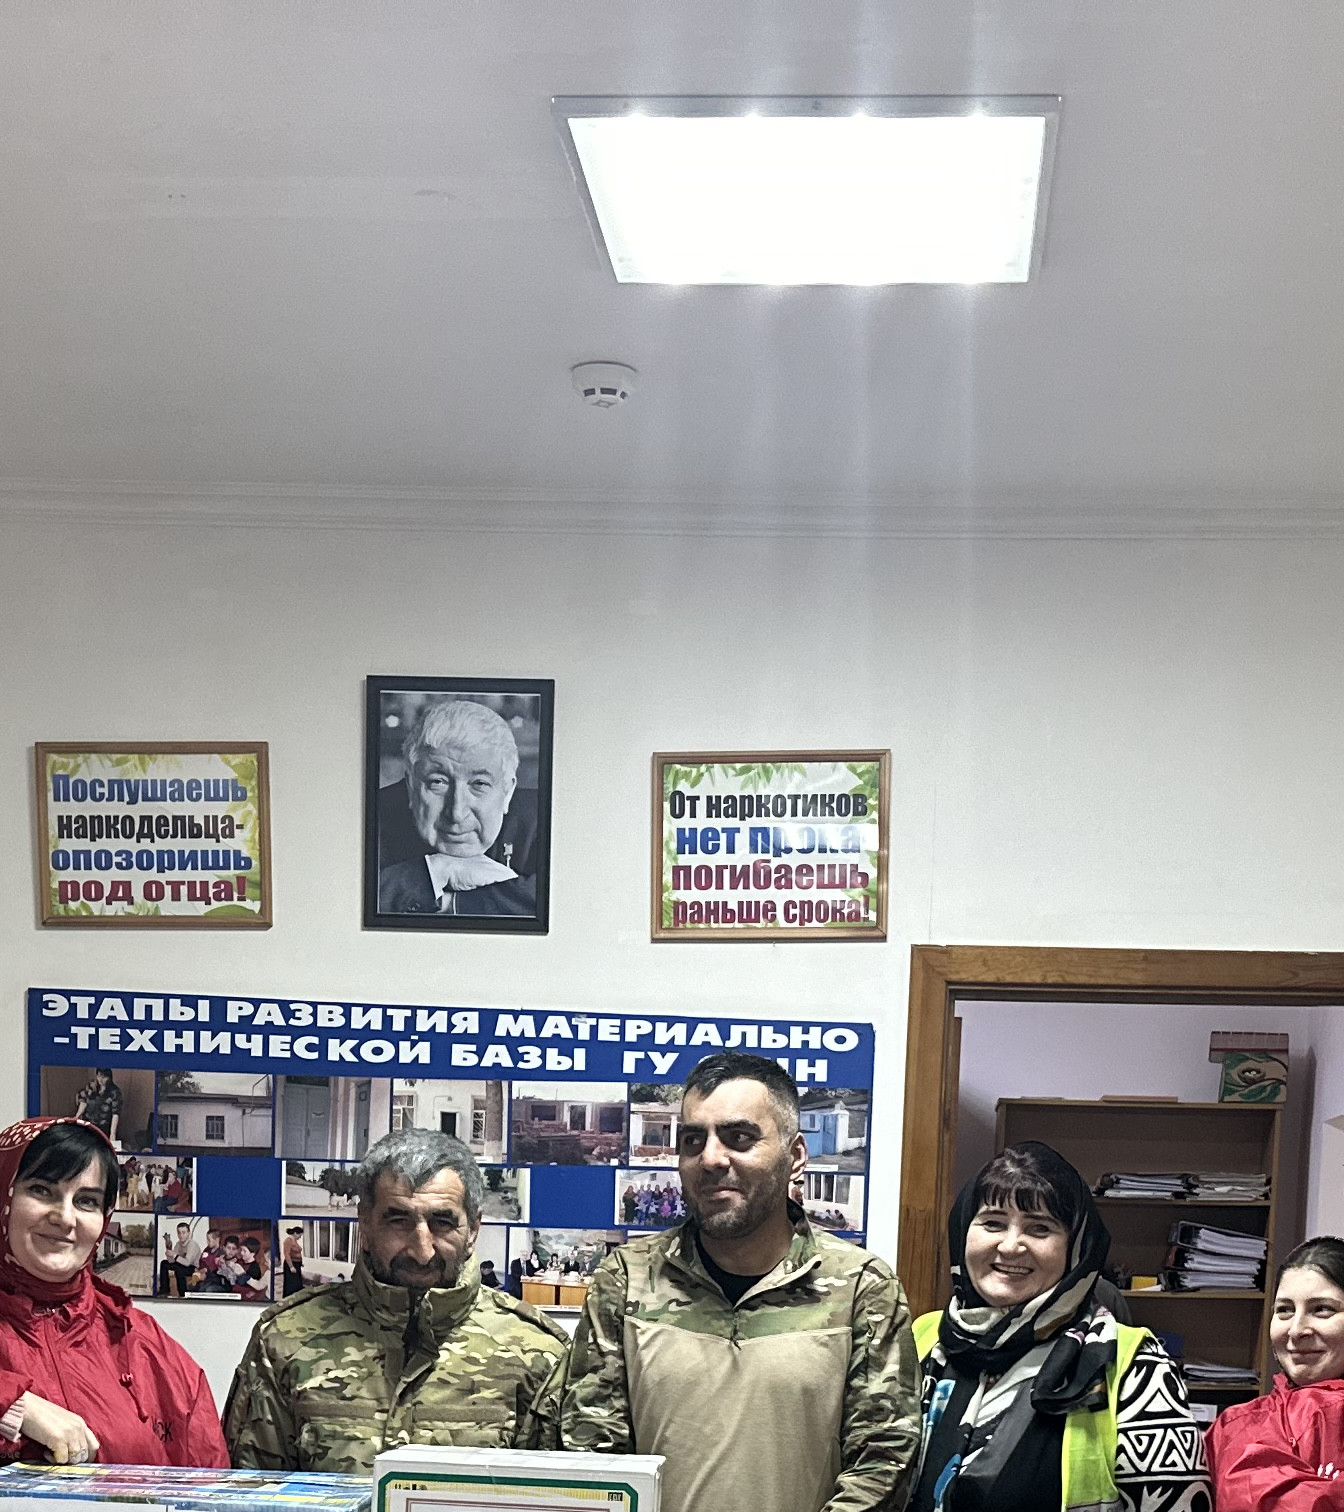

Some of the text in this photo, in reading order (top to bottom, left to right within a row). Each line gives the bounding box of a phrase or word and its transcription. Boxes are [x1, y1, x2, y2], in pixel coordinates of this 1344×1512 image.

[51, 774, 248, 807] Послушаешь
[669, 790, 868, 821] От наркотиков
[56, 811, 245, 844] наркодельца-
[676, 827, 740, 854] нет
[51, 847, 253, 874] опозоришь
[672, 859, 870, 890] погибаешь
[57, 876, 247, 908] род отца!
[673, 894, 870, 927] раньше срока!
[41, 994, 858, 1053] ЭТАПЫ РАЗВИТИЯ МАТЕРИАЛЬНО
[457, 1045, 588, 1074] БАЗЫ
[622, 1050, 678, 1078] ГУ
